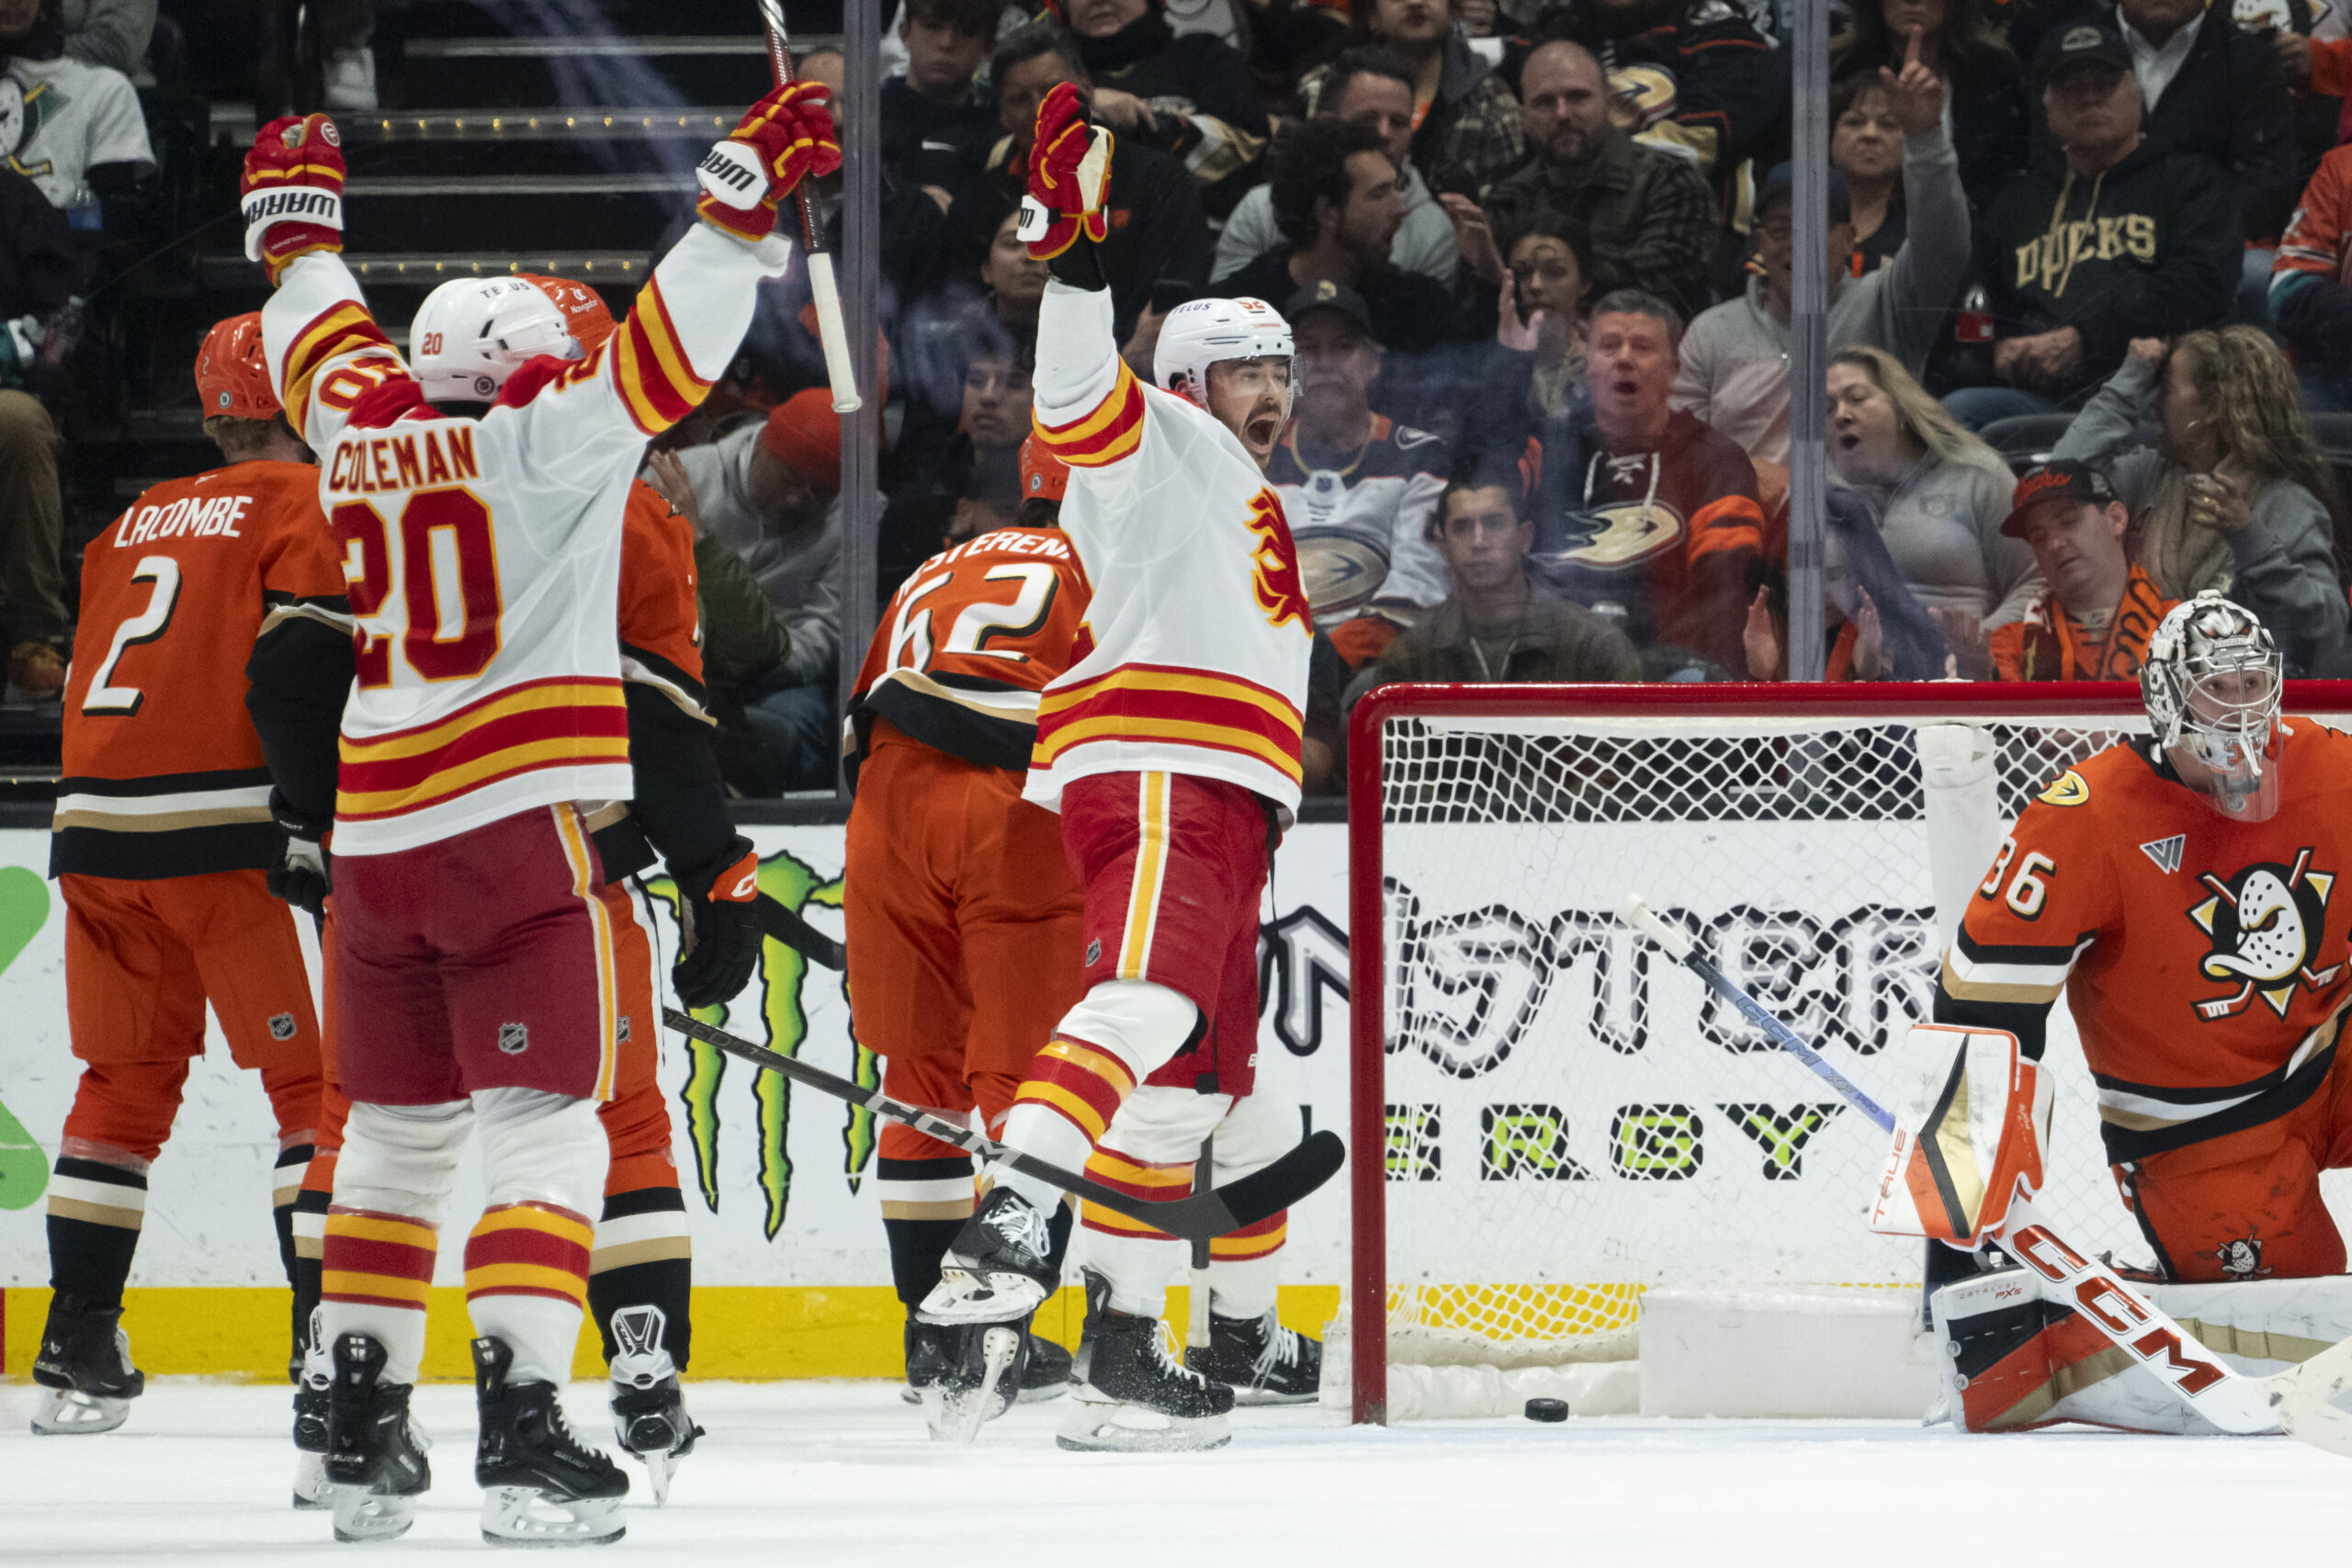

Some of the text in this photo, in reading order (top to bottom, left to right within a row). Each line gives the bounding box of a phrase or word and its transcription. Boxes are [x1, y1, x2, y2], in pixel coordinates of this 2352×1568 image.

[2015, 213, 2155, 288] DUCKS
[421, 332, 443, 355] 20
[329, 425, 480, 494] COLEMAN
[114, 495, 253, 548] LACOMBE
[331, 484, 503, 693] 20
[887, 562, 1059, 674] 62
[82, 556, 182, 717] 2
[1979, 836, 2057, 922] 36
[1736, 996, 1823, 1067] CCM
[865, 1093, 1025, 1167] CCM
[1873, 1128, 1906, 1225] TRUE
[2009, 1224, 2230, 1398] CCM
